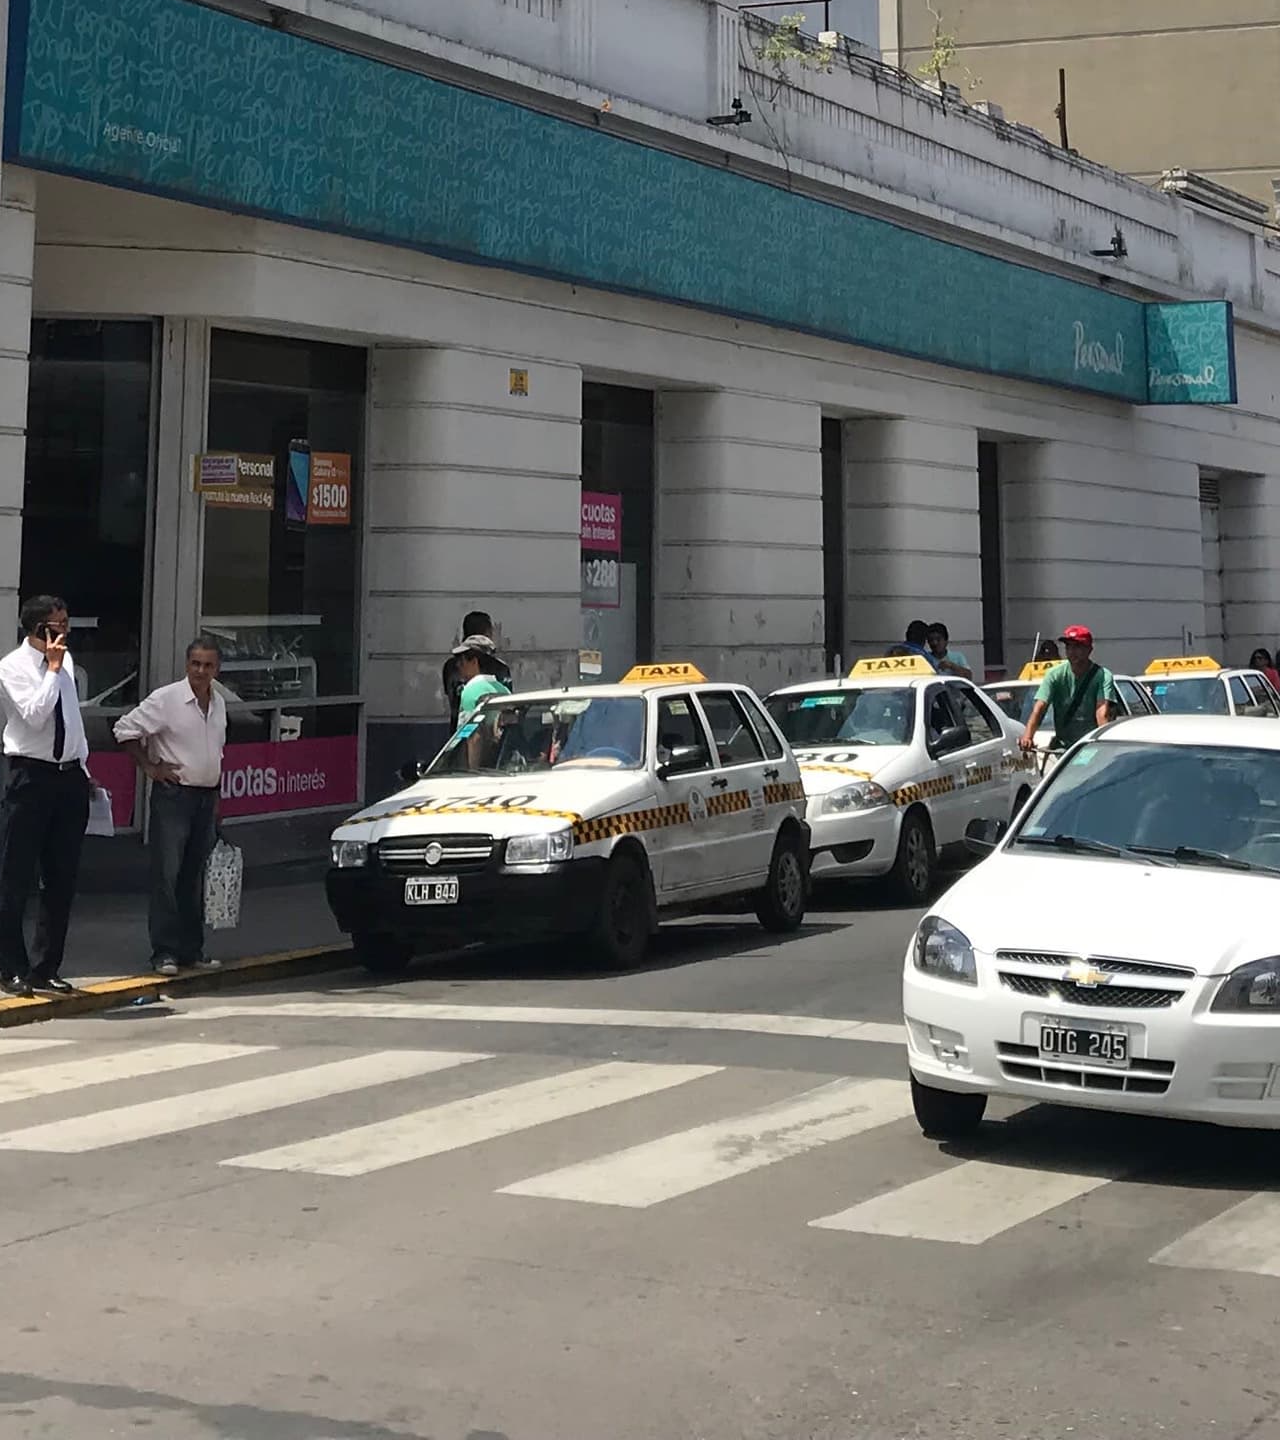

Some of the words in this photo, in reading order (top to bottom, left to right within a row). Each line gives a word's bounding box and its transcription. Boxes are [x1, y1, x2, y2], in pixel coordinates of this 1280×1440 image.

[1072, 320, 1124, 376] Personal
[1148, 365, 1215, 387] Personal
[313, 484, 347, 509] $1500
[582, 502, 616, 523] cuotas
[636, 666, 689, 676] TAXI
[863, 658, 915, 670] TAXI
[220, 764, 277, 799] uotas
[286, 768, 326, 793] interés
[407, 884, 428, 900] KLH
[435, 884, 456, 899] 844
[1042, 1028, 1078, 1053] OTG
[1089, 1034, 1125, 1059] 245
